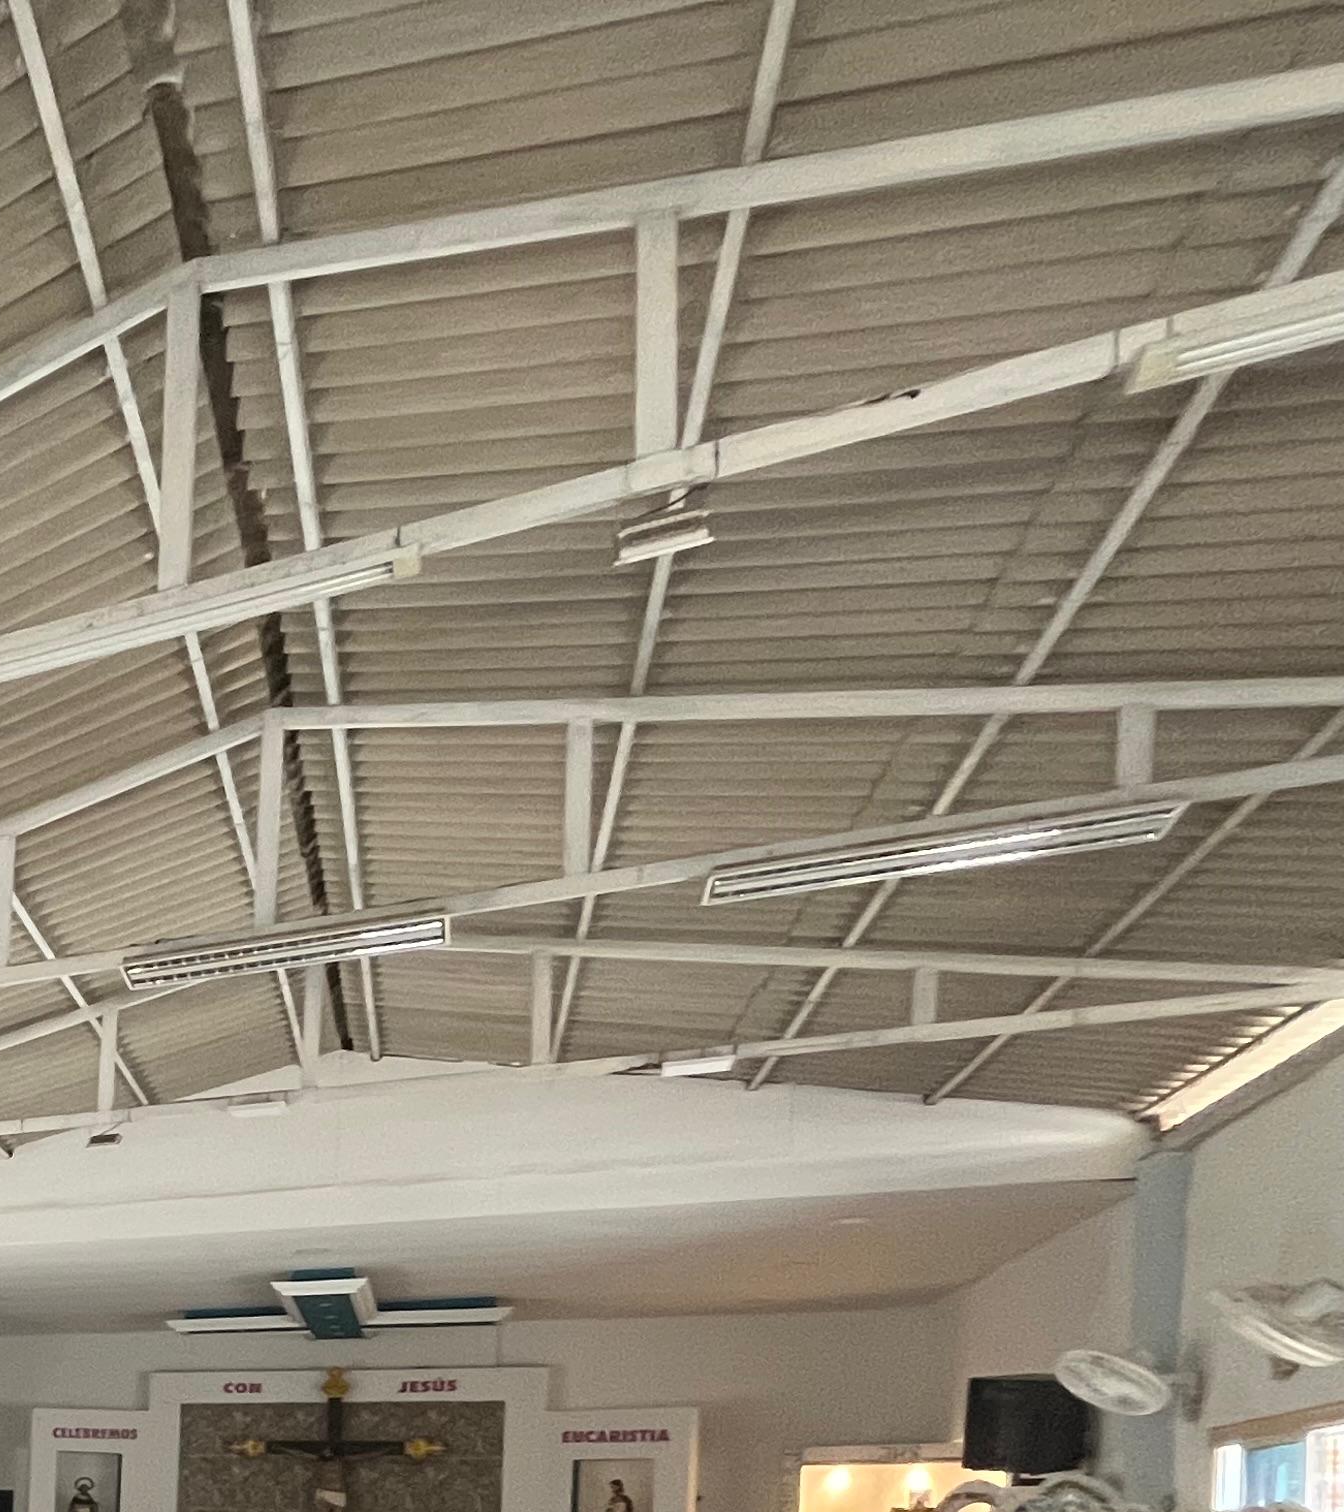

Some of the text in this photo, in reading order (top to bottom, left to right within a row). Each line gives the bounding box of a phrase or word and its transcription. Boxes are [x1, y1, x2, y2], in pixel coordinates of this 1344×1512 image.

[223, 1382, 262, 1394] CON
[398, 1378, 458, 1393] JESÚS
[52, 1427, 138, 1440] CELEBREMOS
[562, 1429, 670, 1443] EUCARISTIA
